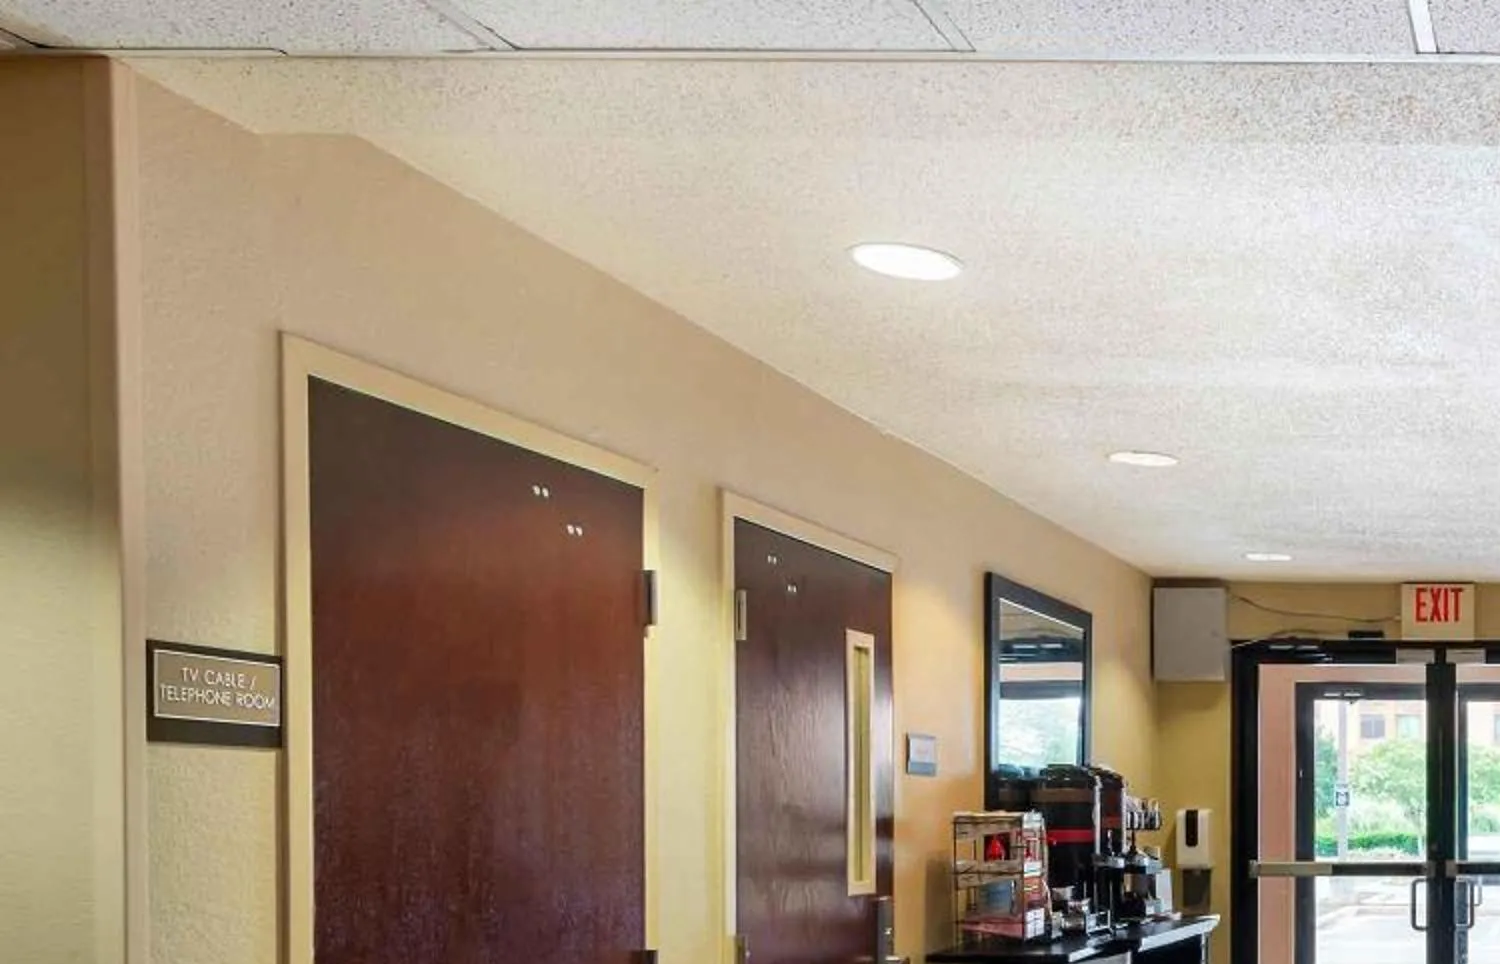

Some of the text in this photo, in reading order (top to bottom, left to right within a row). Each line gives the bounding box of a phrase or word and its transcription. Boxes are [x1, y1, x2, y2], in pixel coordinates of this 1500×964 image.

[1416, 587, 1464, 622] EXIT
[182, 667, 257, 691] TV CABLE /
[160, 684, 275, 709] TELEPHONE ROOM
